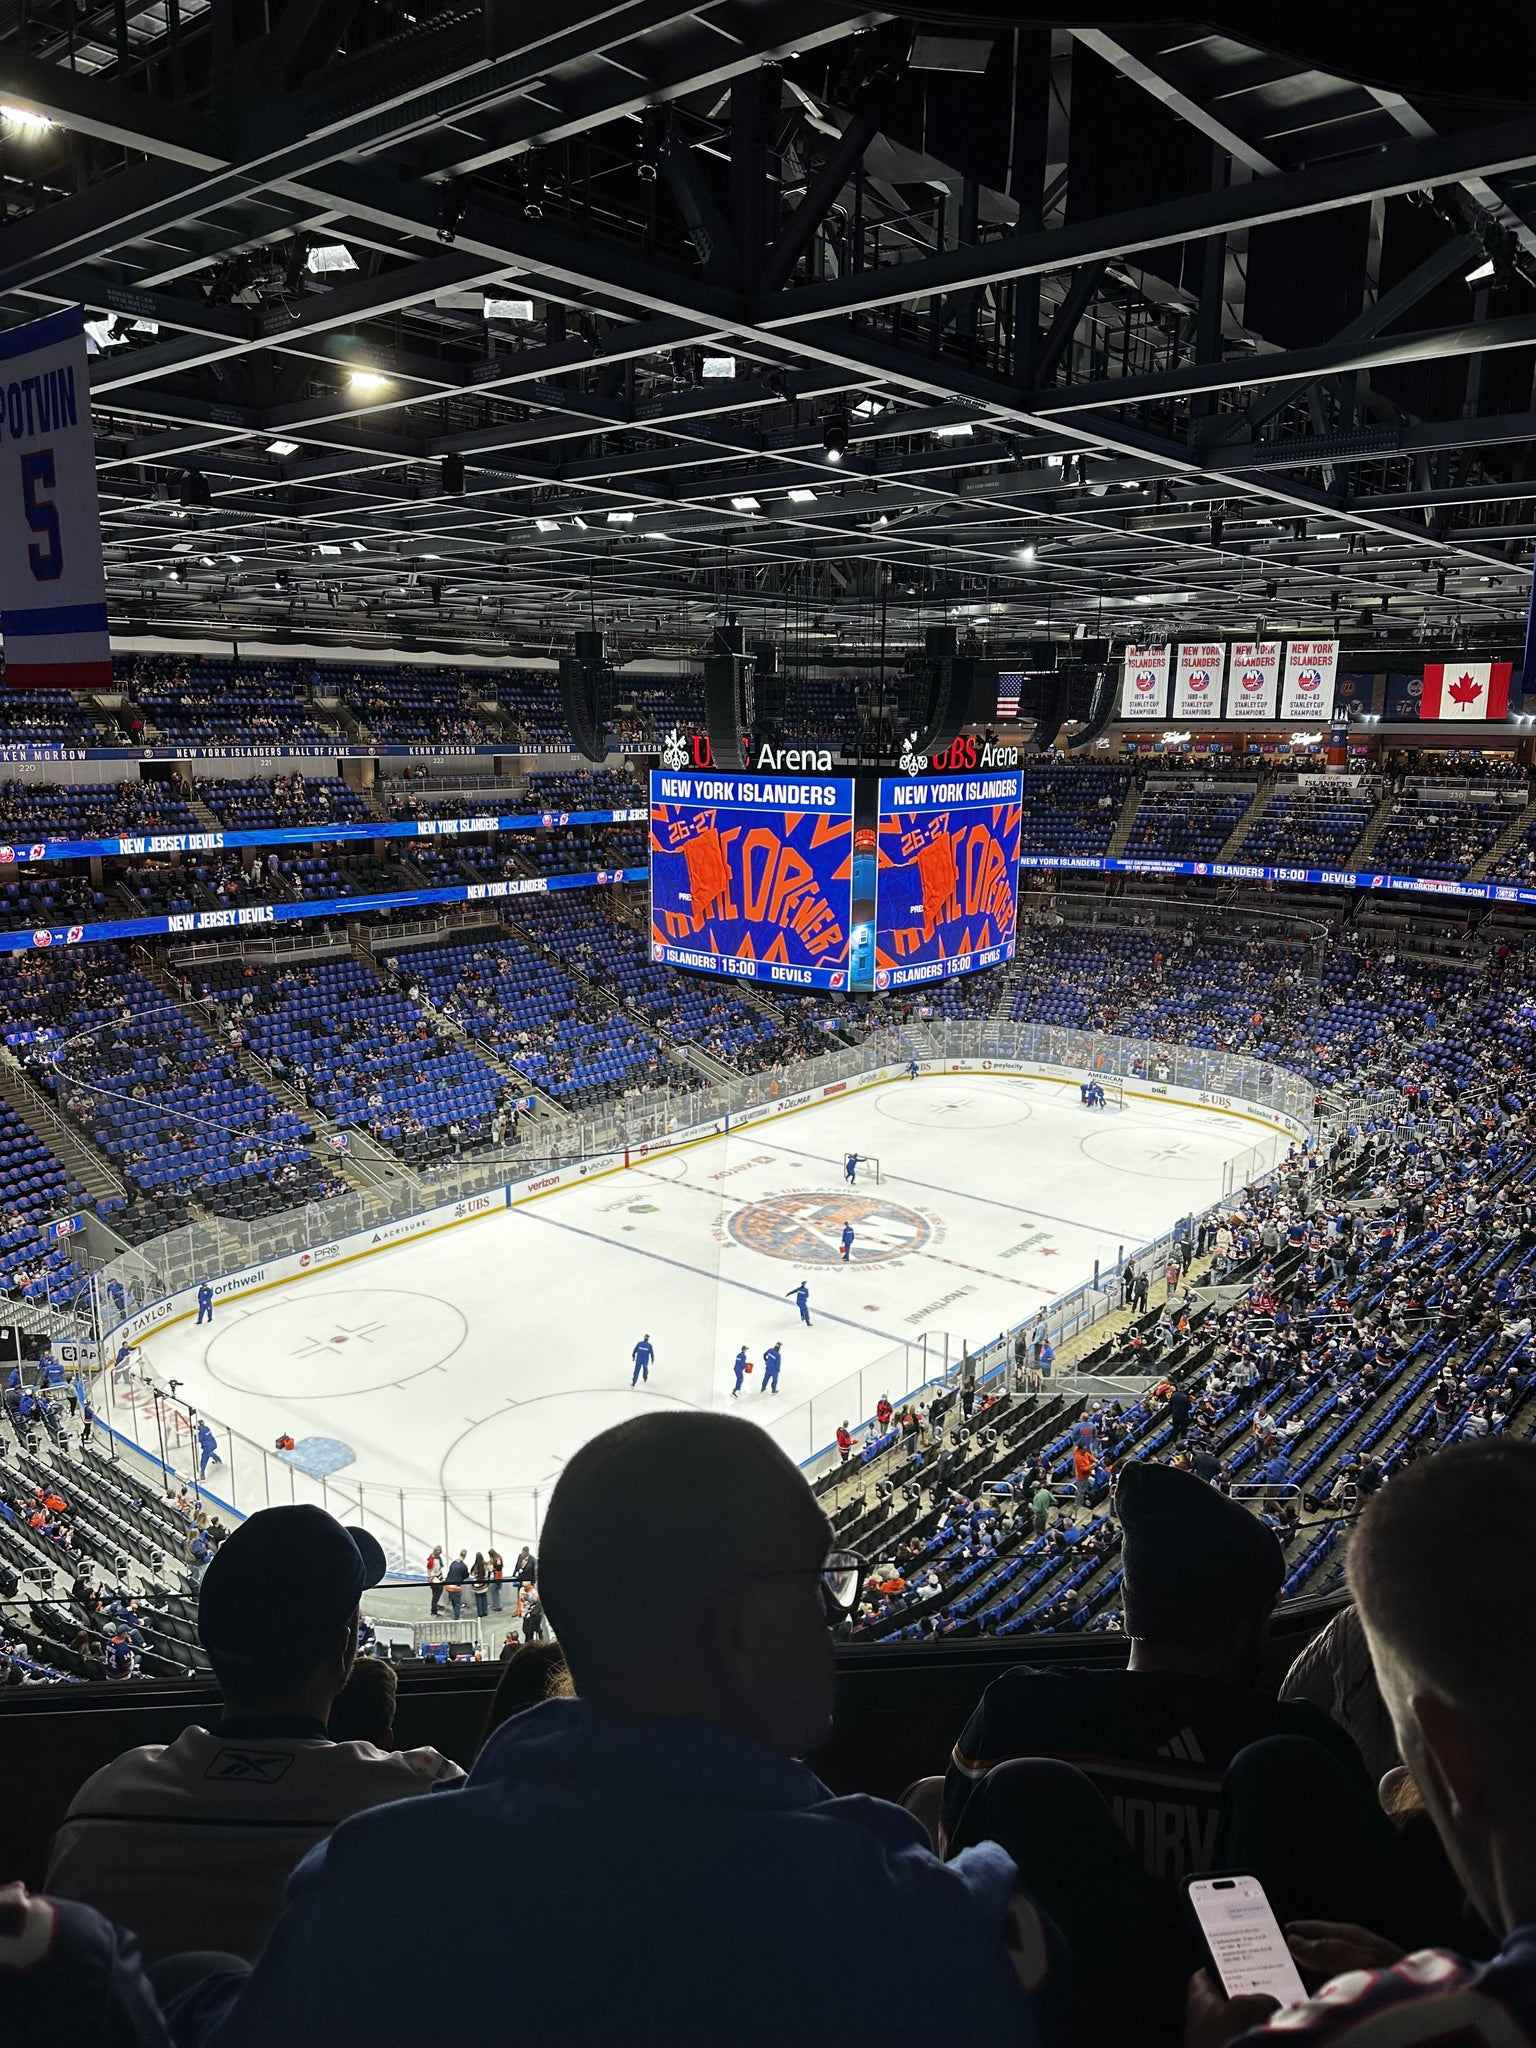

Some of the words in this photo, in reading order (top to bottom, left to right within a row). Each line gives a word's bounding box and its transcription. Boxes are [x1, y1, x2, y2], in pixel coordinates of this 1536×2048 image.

[20, 448, 64, 582] 5
[1182, 646, 1199, 656] NEW
[1201, 646, 1220, 655] YORK
[1236, 646, 1253, 656] NEW
[1255, 644, 1275, 655] YORK
[1292, 644, 1310, 654] NEW
[1312, 644, 1333, 654] YORK
[1128, 658, 1166, 668] ISLANDERS
[1181, 657, 1220, 667] ISLANDERS
[1234, 656, 1276, 667] ISLANDERS
[1289, 656, 1333, 666] ISLANDERS
[1289, 701, 1313, 709] STANLEY
[3, 750, 27, 761] KEN
[34, 749, 87, 761] MORROW
[176, 748, 198, 758] NEW
[201, 747, 227, 757] YORK
[231, 747, 282, 757] ISLANDERS
[289, 746, 311, 757] HALL
[314, 746, 326, 756] OF
[328, 746, 350, 756] FAME
[408, 746, 435, 755] KENNY
[438, 746, 476, 755] JONSSON
[619, 744, 635, 752] PAT
[932, 736, 977, 770] UBS
[980, 742, 1018, 768] Arena
[260, 759, 272, 767] 221
[757, 743, 832, 771] Arena
[18, 764, 36, 772] 220
[1304, 780, 1353, 788] ISLANDERS
[661, 778, 691, 799] NEW
[694, 780, 734, 801] YORK
[737, 782, 837, 806] ISLANDERS
[893, 785, 928, 806] NEW
[931, 783, 964, 803] YORK
[965, 778, 1017, 800] ISLANDERS
[612, 810, 627, 822] NEW
[627, 808, 648, 820] JERSE
[417, 821, 437, 835] NEW
[438, 819, 458, 834] YORK
[459, 817, 499, 832] ISLANDERS
[119, 837, 145, 855] NEW
[147, 834, 187, 852] JERSEY
[188, 832, 224, 850] DEVILS
[1020, 857, 1038, 866] NEW
[1039, 858, 1059, 866] YORK
[1059, 858, 1101, 868] ISLANDERS
[965, 823, 1014, 933] OPENER
[1212, 865, 1264, 878] ISLANDERS
[1272, 868, 1305, 880] 15:00
[1321, 872, 1356, 884] DEVILS
[467, 885, 486, 899] NEW
[487, 882, 508, 898] YORK
[508, 877, 548, 896] ISLANDERS
[742, 827, 843, 956] OPENER
[1392, 880, 1485, 897] NEWYORKISLANDERS.COM
[168, 914, 195, 932] NEW
[196, 909, 236, 929] JERSEY
[239, 906, 273, 924] DEVILS
[666, 948, 717, 970] ISLANDERS
[946, 955, 971, 974] 15:00
[979, 949, 1001, 966] DEVILS
[721, 959, 756, 976] 15:00
[771, 966, 812, 983] DEVILS
[892, 960, 943, 984] ISLANDERS
[920, 1062, 931, 1071] BS
[993, 1062, 1023, 1071] paylocity
[1087, 1071, 1124, 1083] AMERICAN
[1151, 1086, 1168, 1095] DIME
[784, 1095, 811, 1110] DELMAR
[1211, 1095, 1231, 1107] UBS
[1247, 1106, 1272, 1120] Heineken
[649, 1138, 672, 1150] xerox
[586, 1157, 615, 1171] VANDA
[708, 1161, 753, 1181] xerox
[527, 1176, 560, 1192] verizon
[467, 1196, 491, 1212] UBS
[383, 1220, 426, 1238] ACRISURE
[314, 1244, 340, 1259] PRO
[998, 1232, 1054, 1259] Heineken
[215, 1270, 265, 1295] orthwell
[903, 1290, 969, 1325] Northwell
[132, 1302, 174, 1332] TAYLOR
